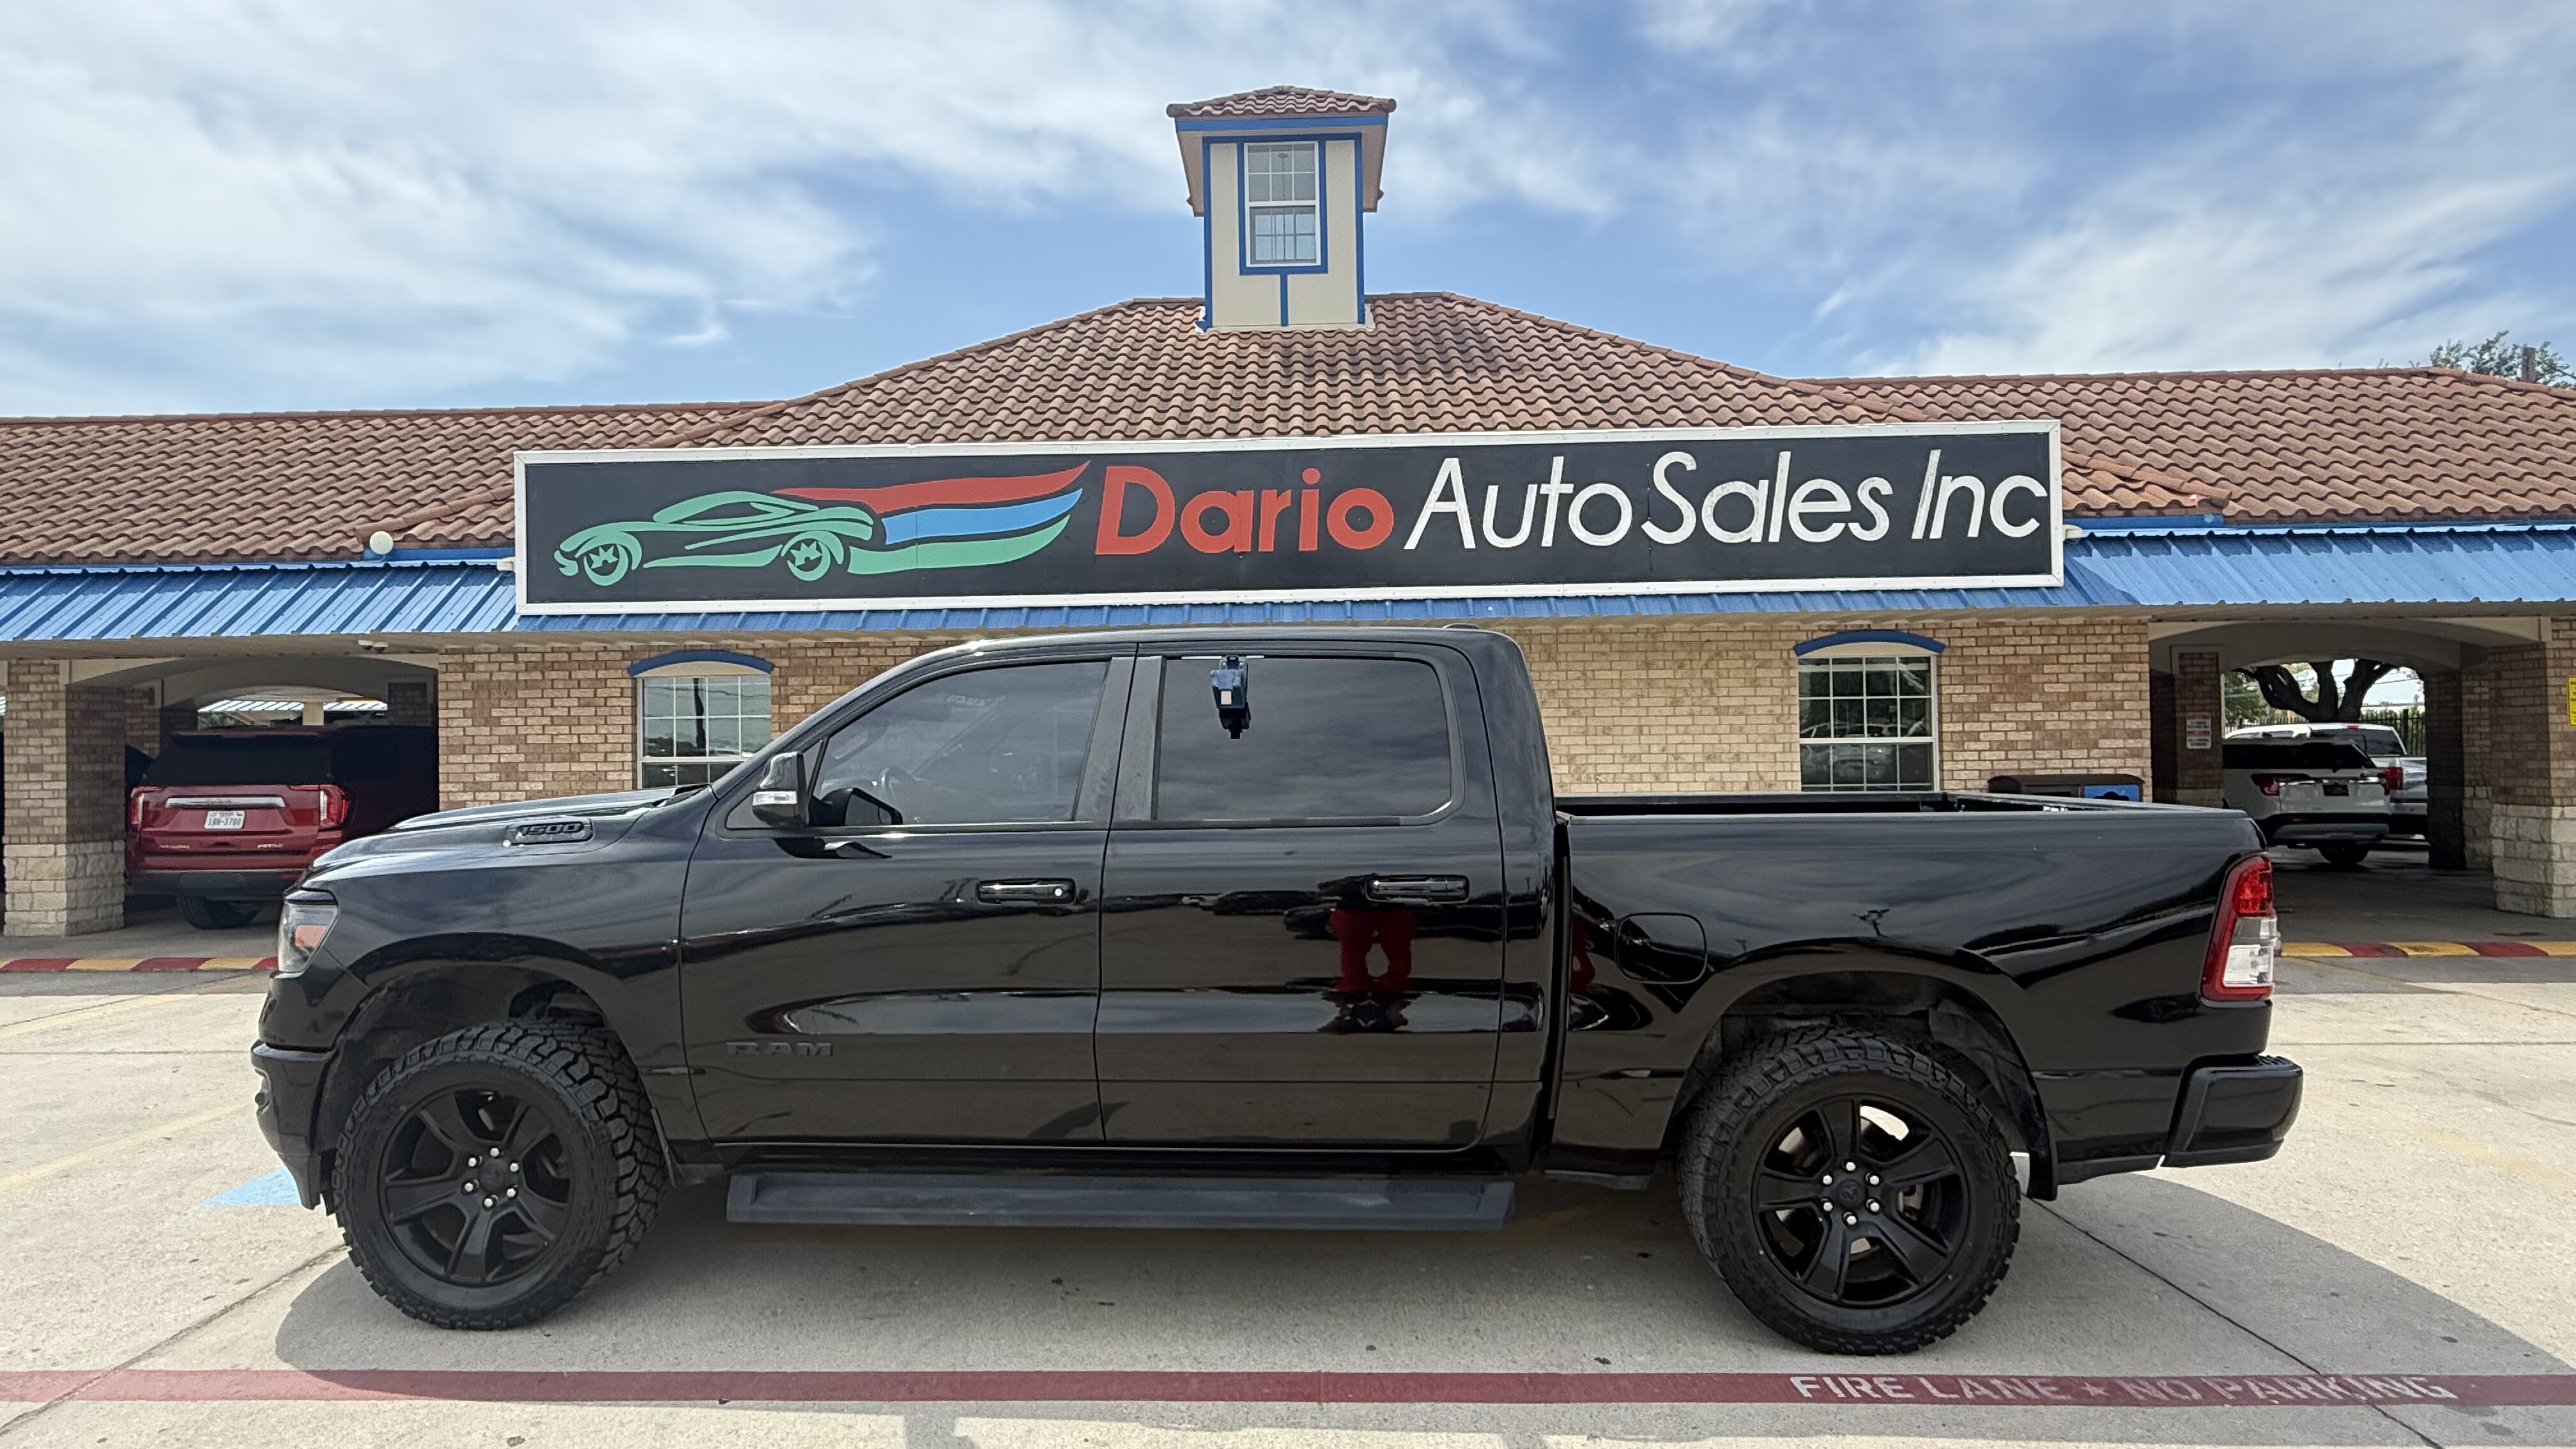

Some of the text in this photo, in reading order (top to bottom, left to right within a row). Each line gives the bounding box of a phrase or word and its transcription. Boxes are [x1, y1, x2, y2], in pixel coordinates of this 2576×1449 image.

[1096, 466, 1394, 554] Dario
[1910, 448, 2048, 542] Inc
[521, 824, 579, 836] 1500
[726, 1041, 834, 1056] RAM
[1789, 1376, 2459, 1401] FIRE LANE NO PARKING
